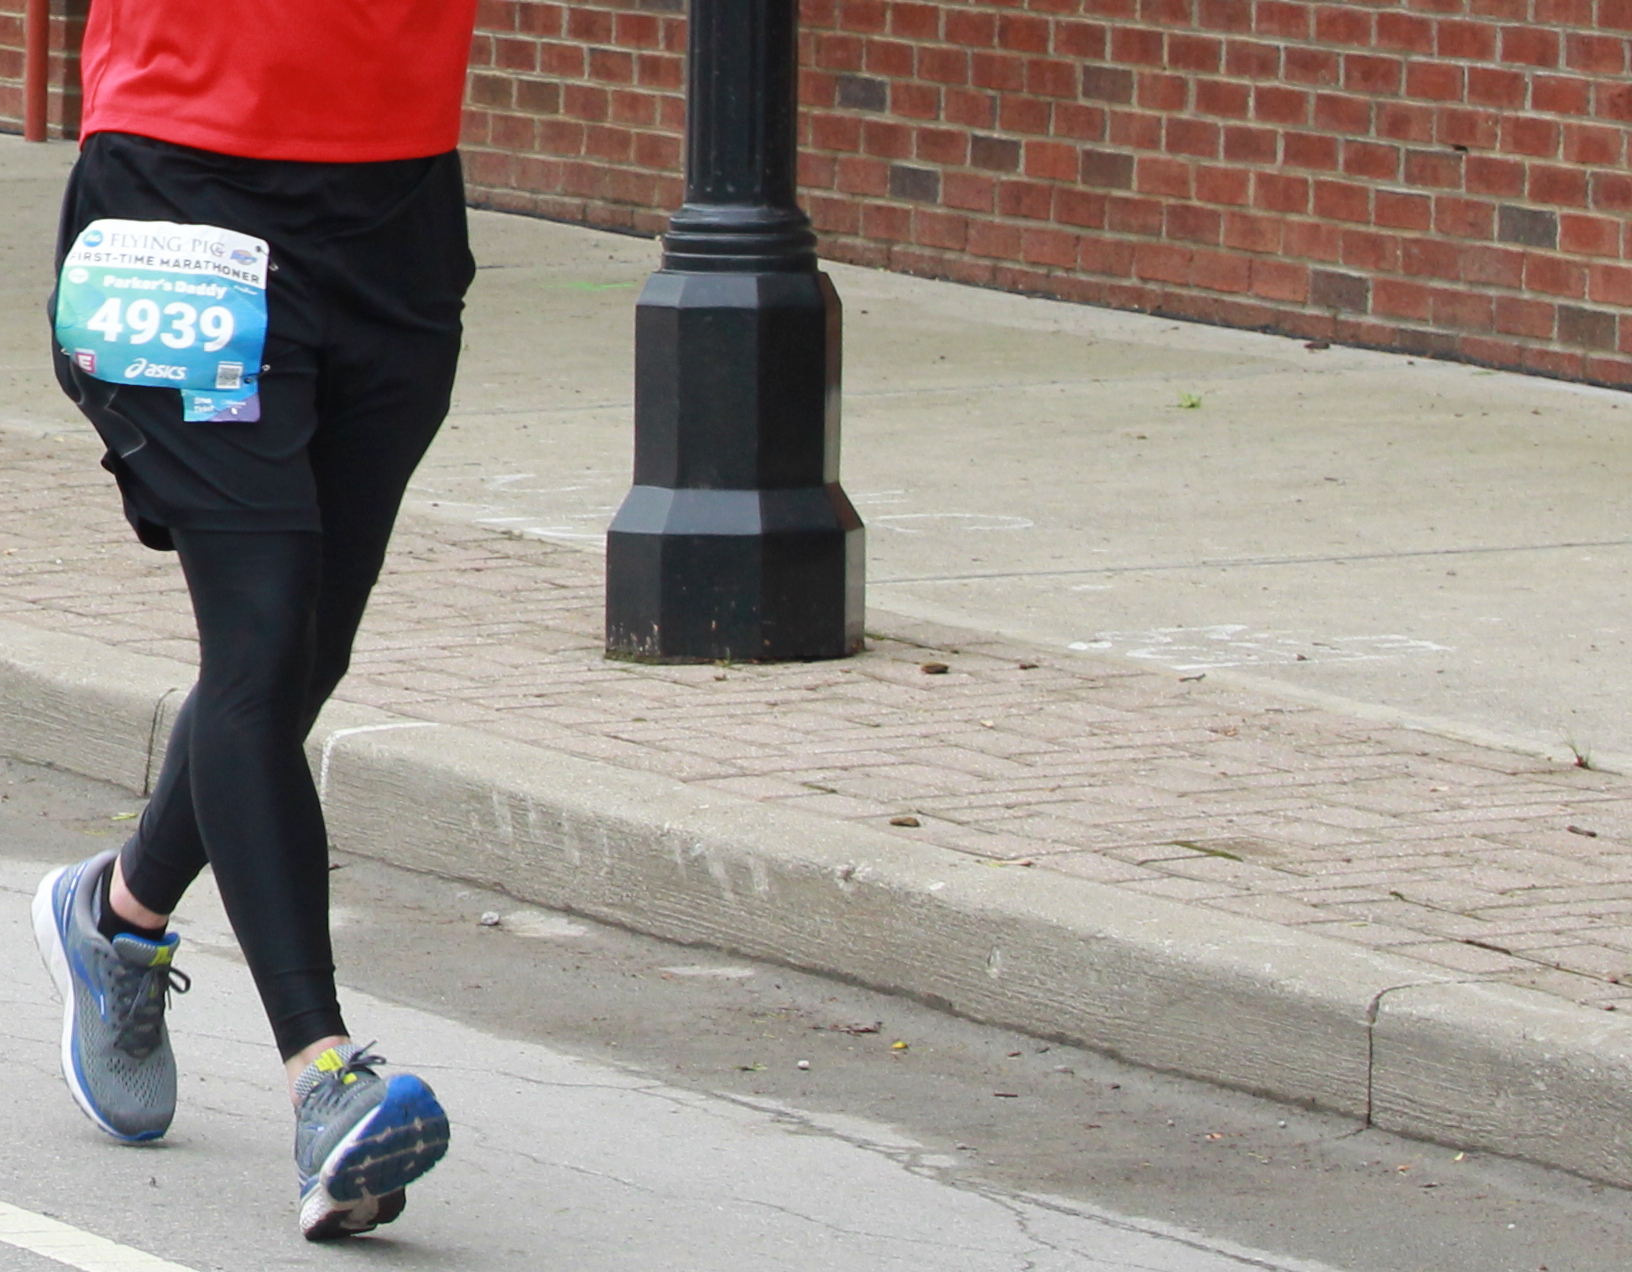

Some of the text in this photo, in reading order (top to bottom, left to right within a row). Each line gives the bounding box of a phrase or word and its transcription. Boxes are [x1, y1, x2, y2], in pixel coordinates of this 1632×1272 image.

[110, 233, 182, 253] FLYING
[191, 239, 225, 258] PIG
[70, 251, 261, 285] FIRST-TIME MARATHONER
[103, 275, 172, 293] Parker's
[174, 280, 227, 299] Daddy
[86, 297, 234, 352] 4939
[79, 355, 93, 371] E
